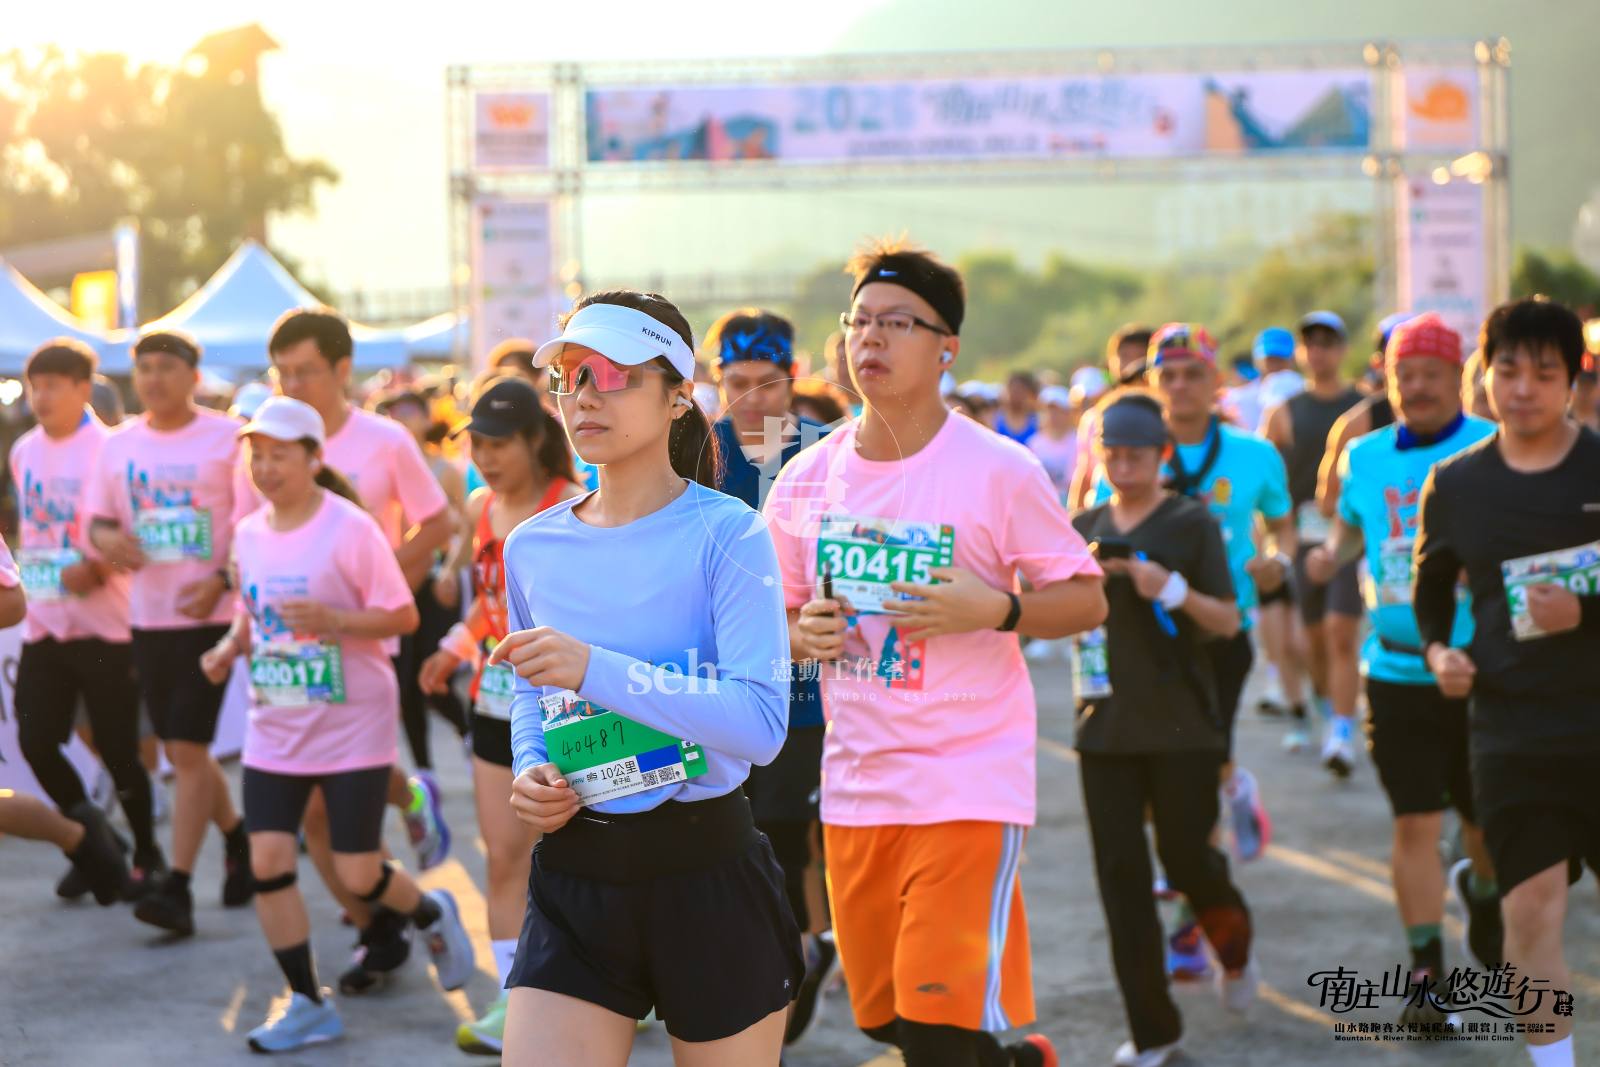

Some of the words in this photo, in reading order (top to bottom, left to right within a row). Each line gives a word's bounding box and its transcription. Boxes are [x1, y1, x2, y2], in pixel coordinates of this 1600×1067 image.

[642, 327, 672, 347] KIPRUN
[822, 543, 934, 586] 30415
[562, 720, 624, 760] 40487
[601, 760, 638, 780] 10公里
